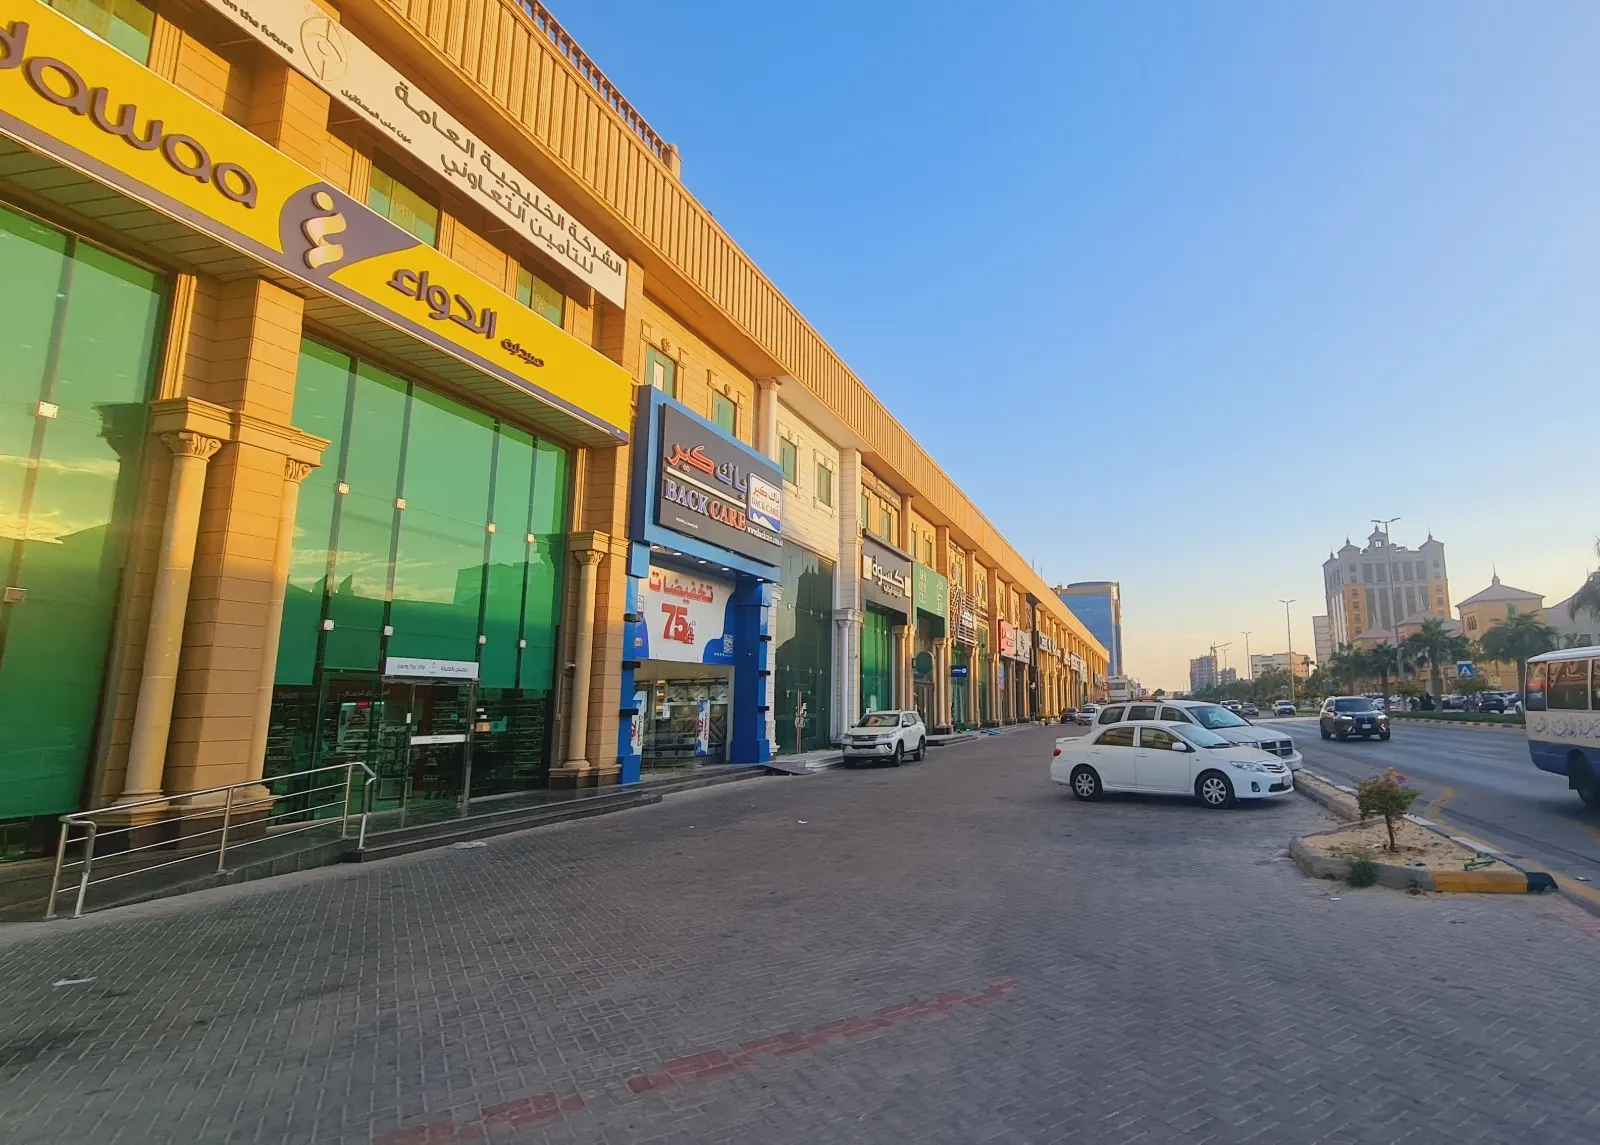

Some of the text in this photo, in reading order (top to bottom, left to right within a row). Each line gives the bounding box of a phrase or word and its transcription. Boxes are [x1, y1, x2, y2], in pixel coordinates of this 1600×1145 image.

[239, 8, 259, 28] the
[260, 24, 294, 54] future
[340, 89, 412, 145] عين على المستقبل
[394, 81, 623, 276] الشركة الخليجية العامة
[440, 152, 594, 275] للتأمين التعاوني
[385, 268, 545, 367] صيدلية الدواء
[666, 443, 715, 474] كير
[664, 478, 748, 532] BACK CARE
[648, 570, 714, 605] تخفيضات
